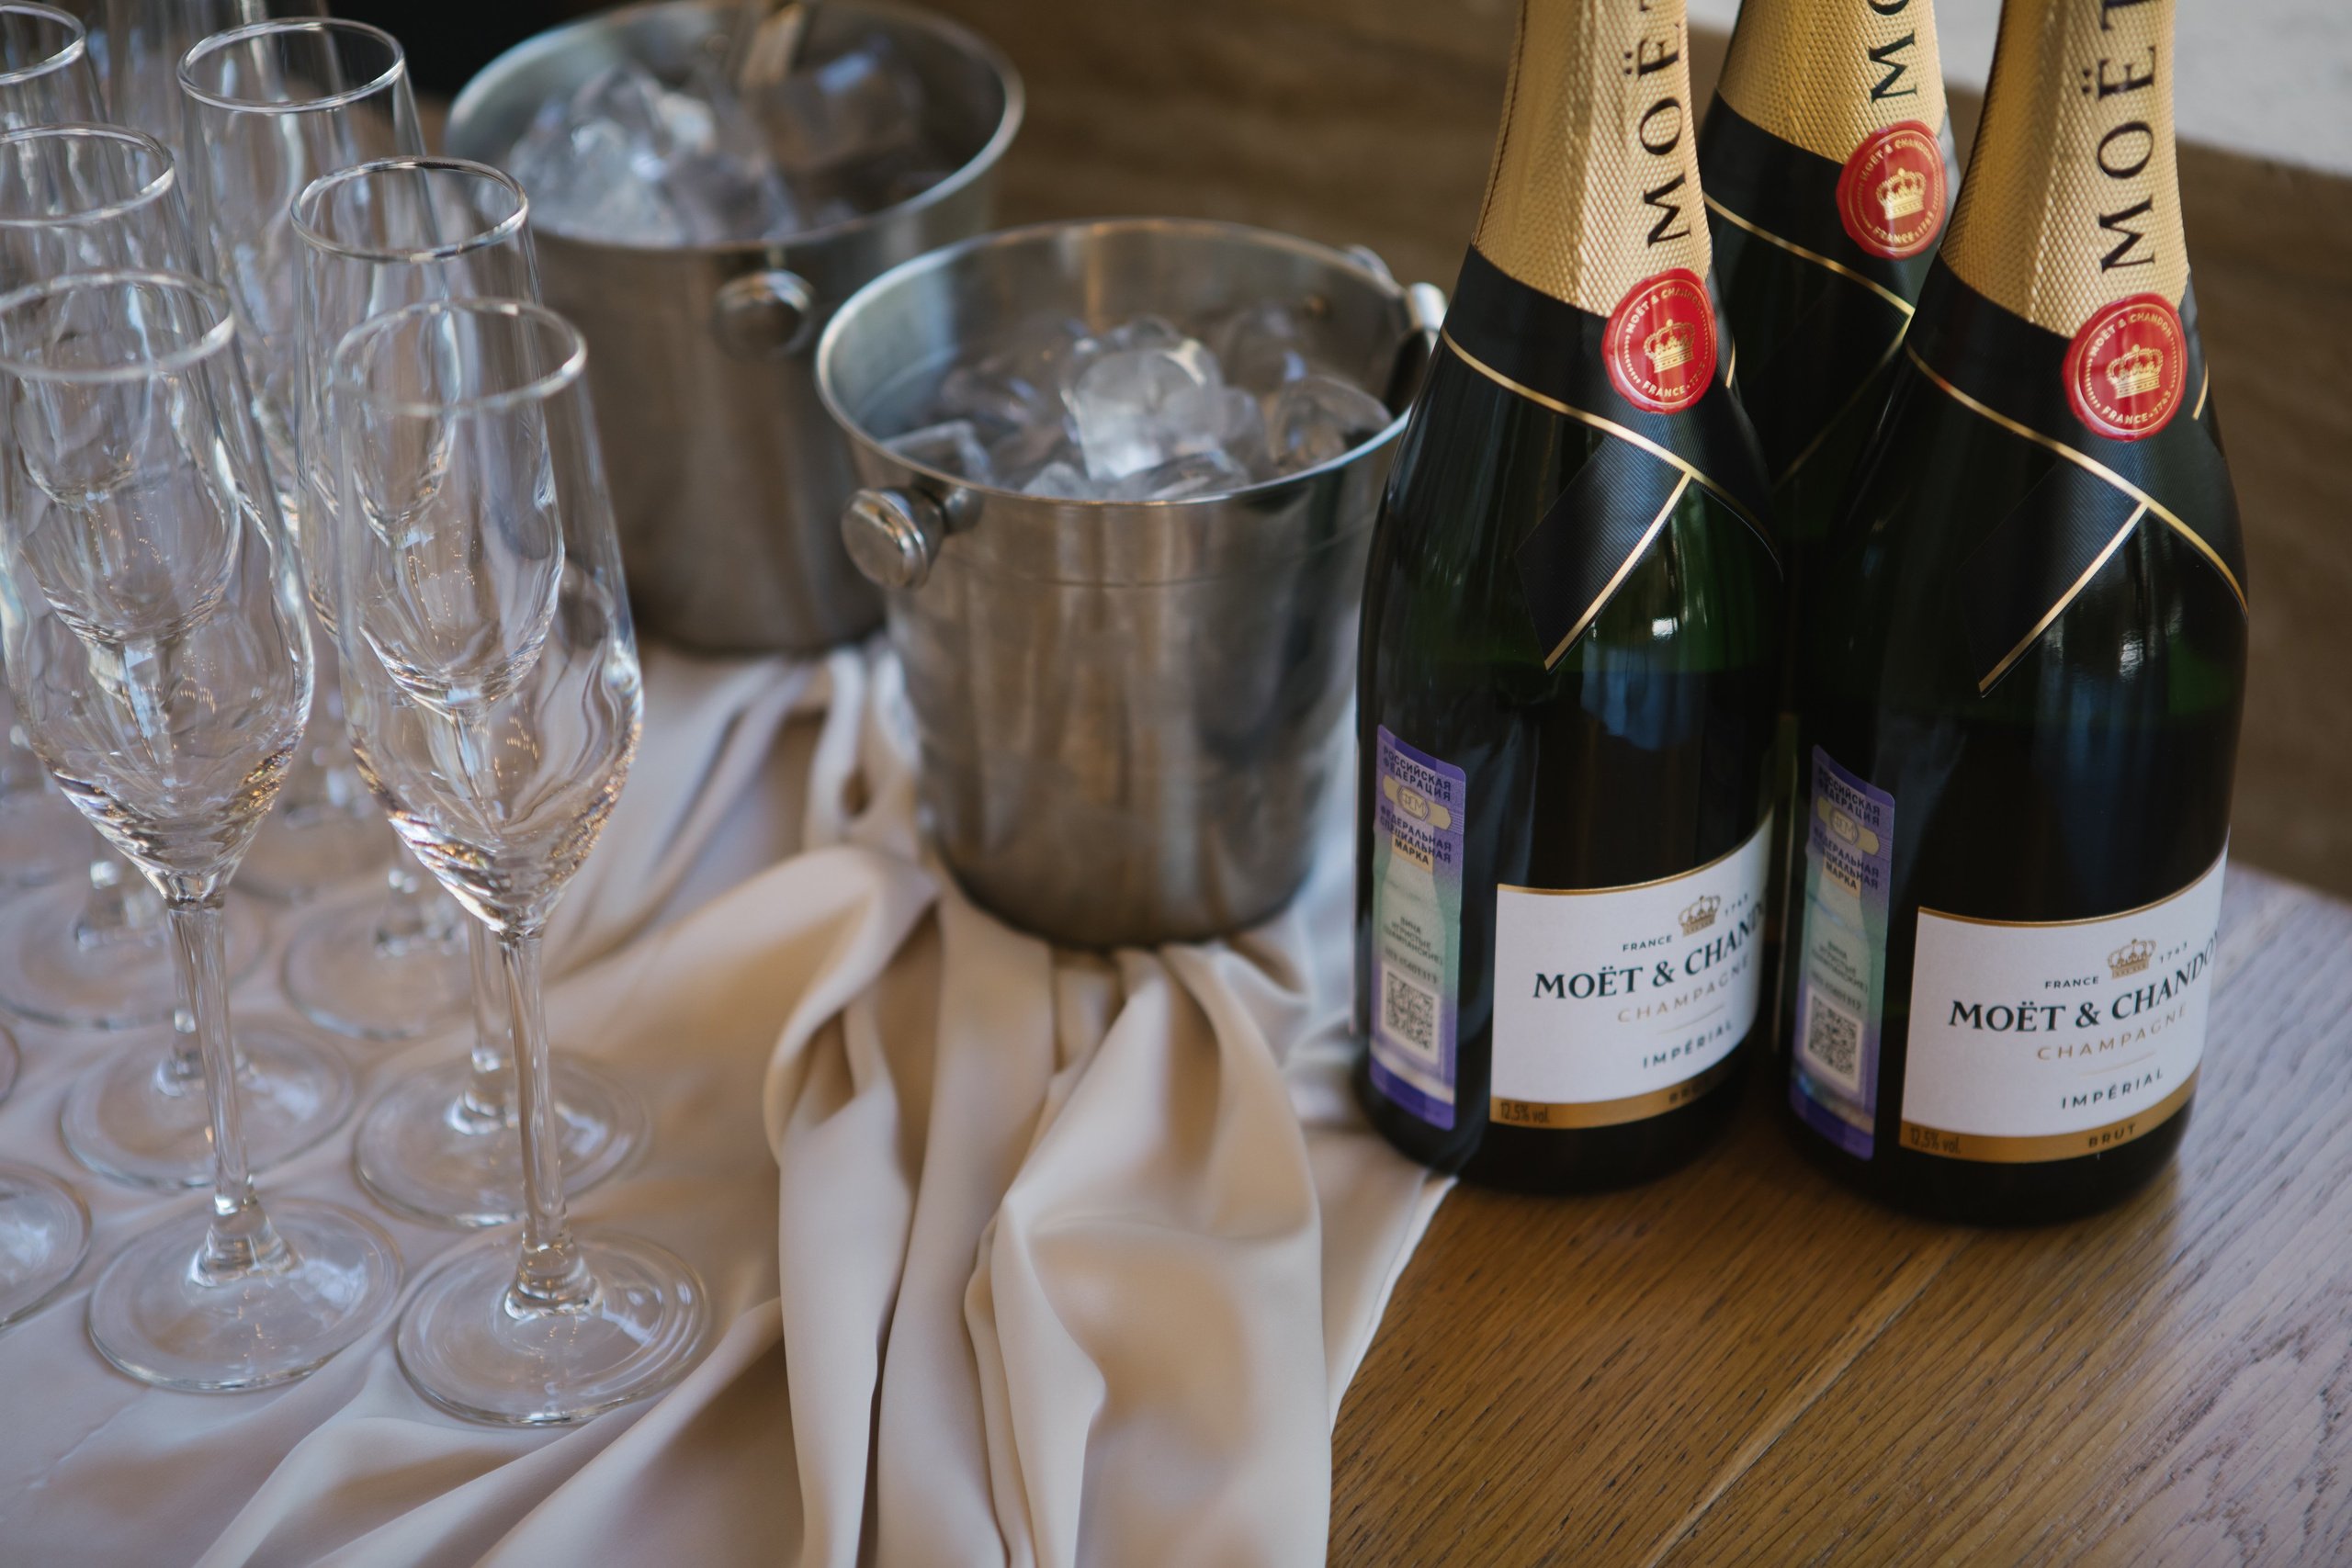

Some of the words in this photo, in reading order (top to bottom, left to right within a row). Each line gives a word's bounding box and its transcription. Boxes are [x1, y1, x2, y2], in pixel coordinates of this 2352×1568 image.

[2130, 312, 2173, 339] CHANDON
[2102, 405, 2149, 424] FRANCE
[1383, 746, 1452, 792] РОССИЙСКАЯ
[1383, 757, 1452, 802] ФЕДЕРАЦИЯ
[1818, 766, 1881, 818] РОССИЙСКАЯ
[1380, 805, 1452, 852] ФЕДЕРАЛЬНАЯ
[1380, 816, 1452, 863] СПЕЦИАЛЬНАЯ
[1394, 838, 1430, 865] МАРКА
[1826, 861, 1858, 891] МАРКА
[1622, 934, 1673, 953] FRANCE
[1532, 965, 1644, 1000] MOËT
[1652, 961, 1676, 987] &
[1617, 953, 1749, 1024] CHAMPAGNE
[2044, 976, 2100, 990] FRANCE
[1948, 999, 2067, 1033] MOËT
[2075, 1001, 2101, 1027] &
[2037, 1002, 2186, 1061] CHAMPAGNE
[1643, 1019, 1732, 1069] IMPÉRIAL
[2062, 1068, 2164, 1110] IMPÉRIAL
[2088, 1122, 2137, 1148] BRUT
